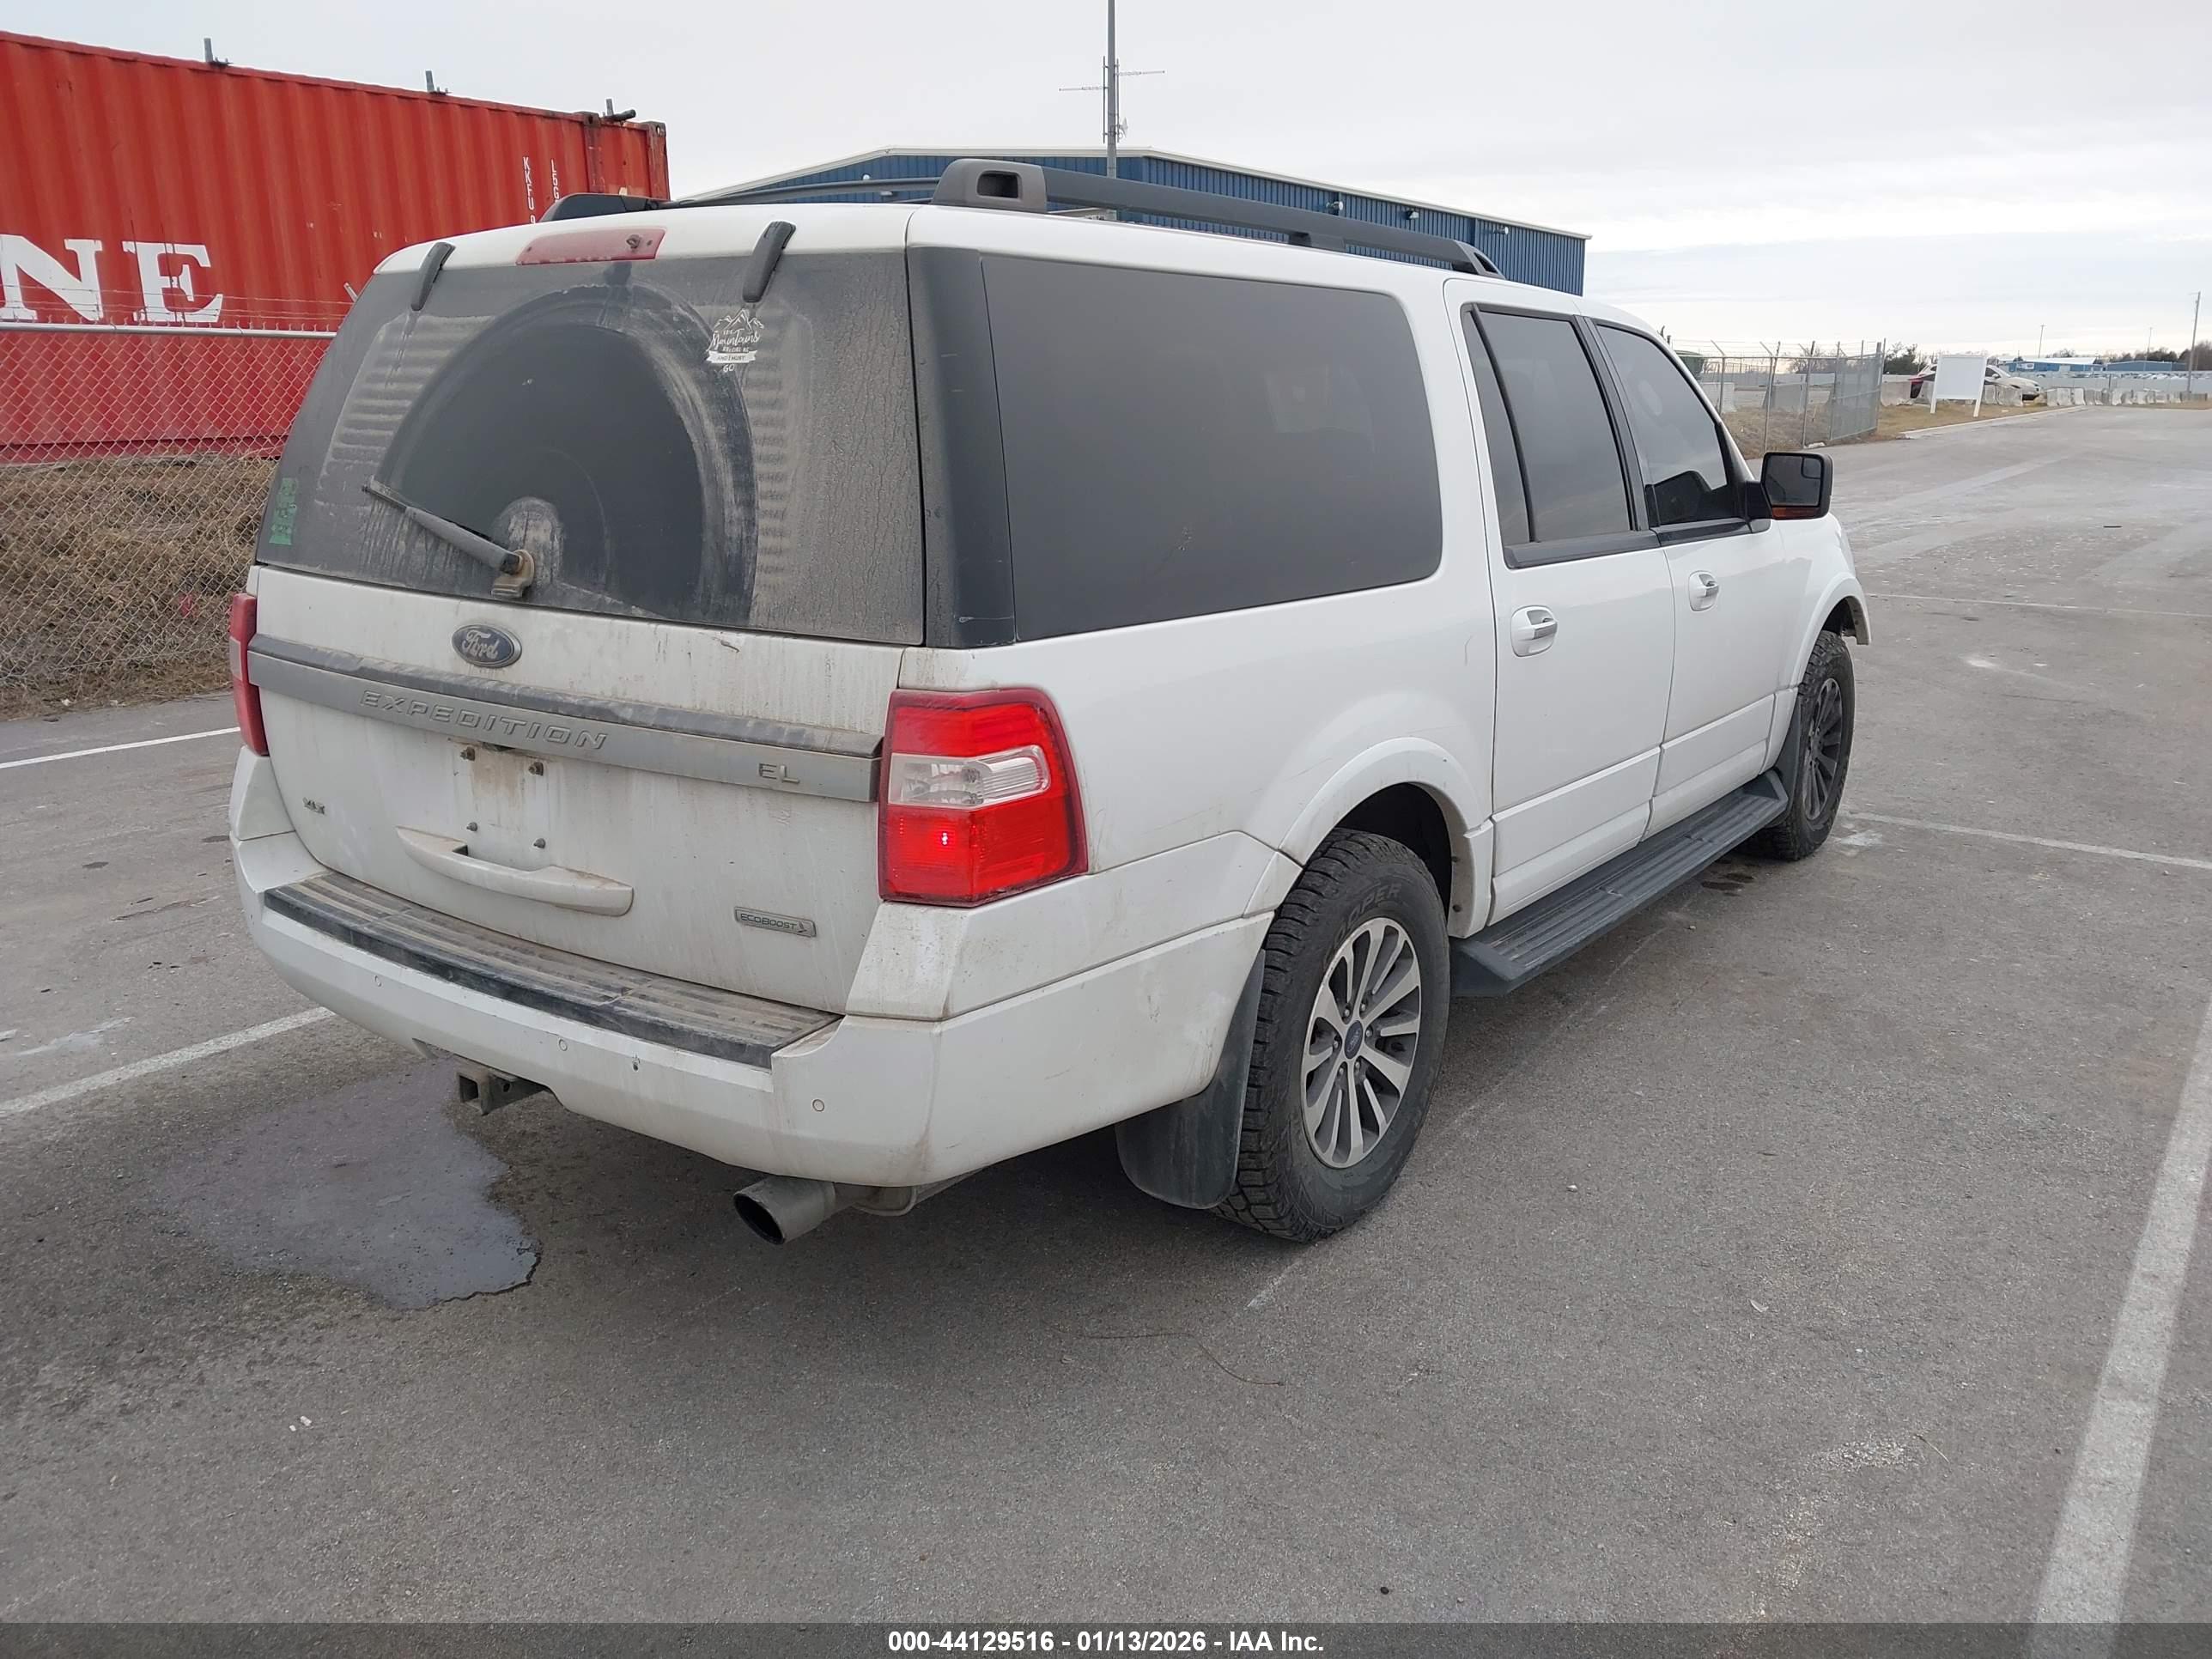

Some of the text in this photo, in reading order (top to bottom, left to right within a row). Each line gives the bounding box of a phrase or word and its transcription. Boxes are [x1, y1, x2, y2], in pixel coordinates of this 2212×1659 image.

[523, 156, 535, 210] KKFU
[722, 364, 735, 373] GO
[461, 628, 501, 659] Ford
[359, 690, 800, 784] EXPEDITION EL
[739, 912, 798, 931] ECOBOOST
